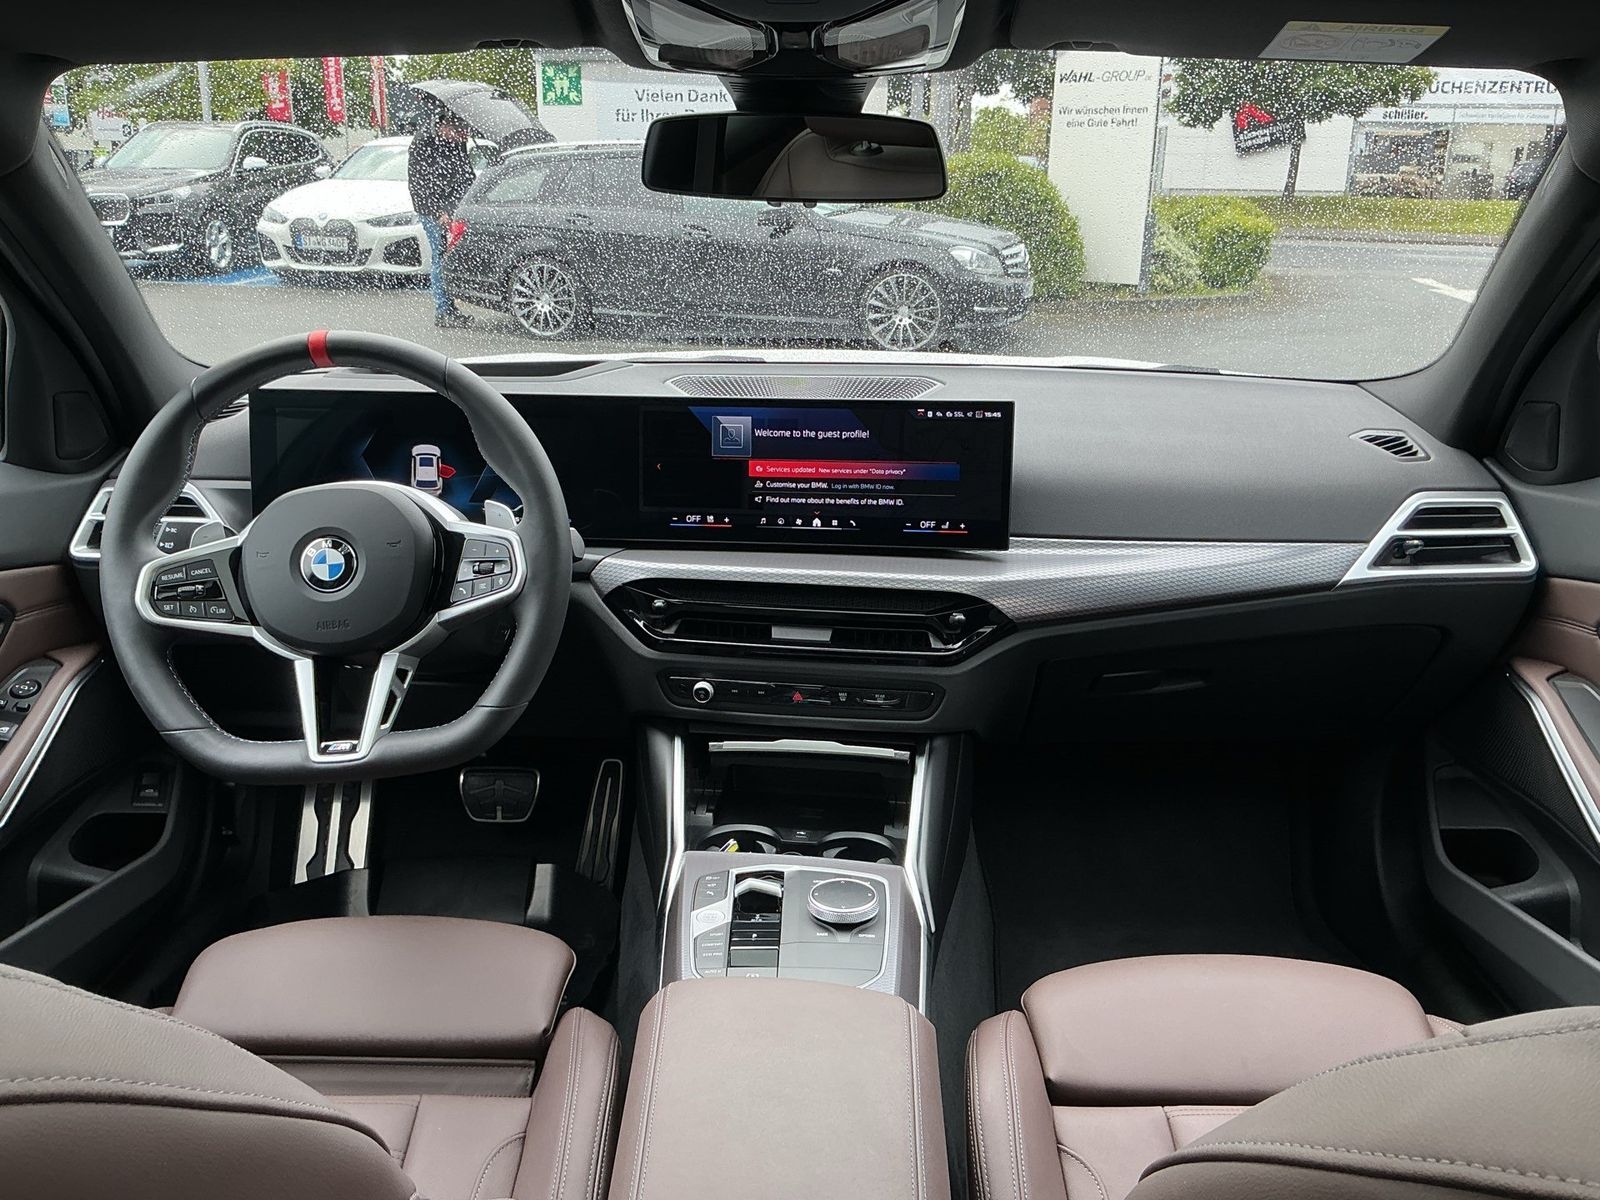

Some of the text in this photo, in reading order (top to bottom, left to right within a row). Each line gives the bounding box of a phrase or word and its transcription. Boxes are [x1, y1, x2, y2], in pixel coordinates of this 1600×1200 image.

[635, 89, 728, 102] Vielen Dank
[615, 108, 637, 122] für
[754, 428, 870, 440] Welcome to the guest profile!
[766, 465, 816, 474] Services updated
[765, 480, 828, 490] Customise your BMW.
[835, 497, 860, 505] benefits
[867, 498, 878, 506] the
[878, 498, 895, 506] BMW
[685, 514, 702, 523] OFF
[919, 520, 936, 529] OFF
[306, 539, 351, 558] BMW
[190, 567, 212, 576] CANCEL
[161, 572, 184, 581] RESUME
[315, 619, 352, 631] AIRBAG
